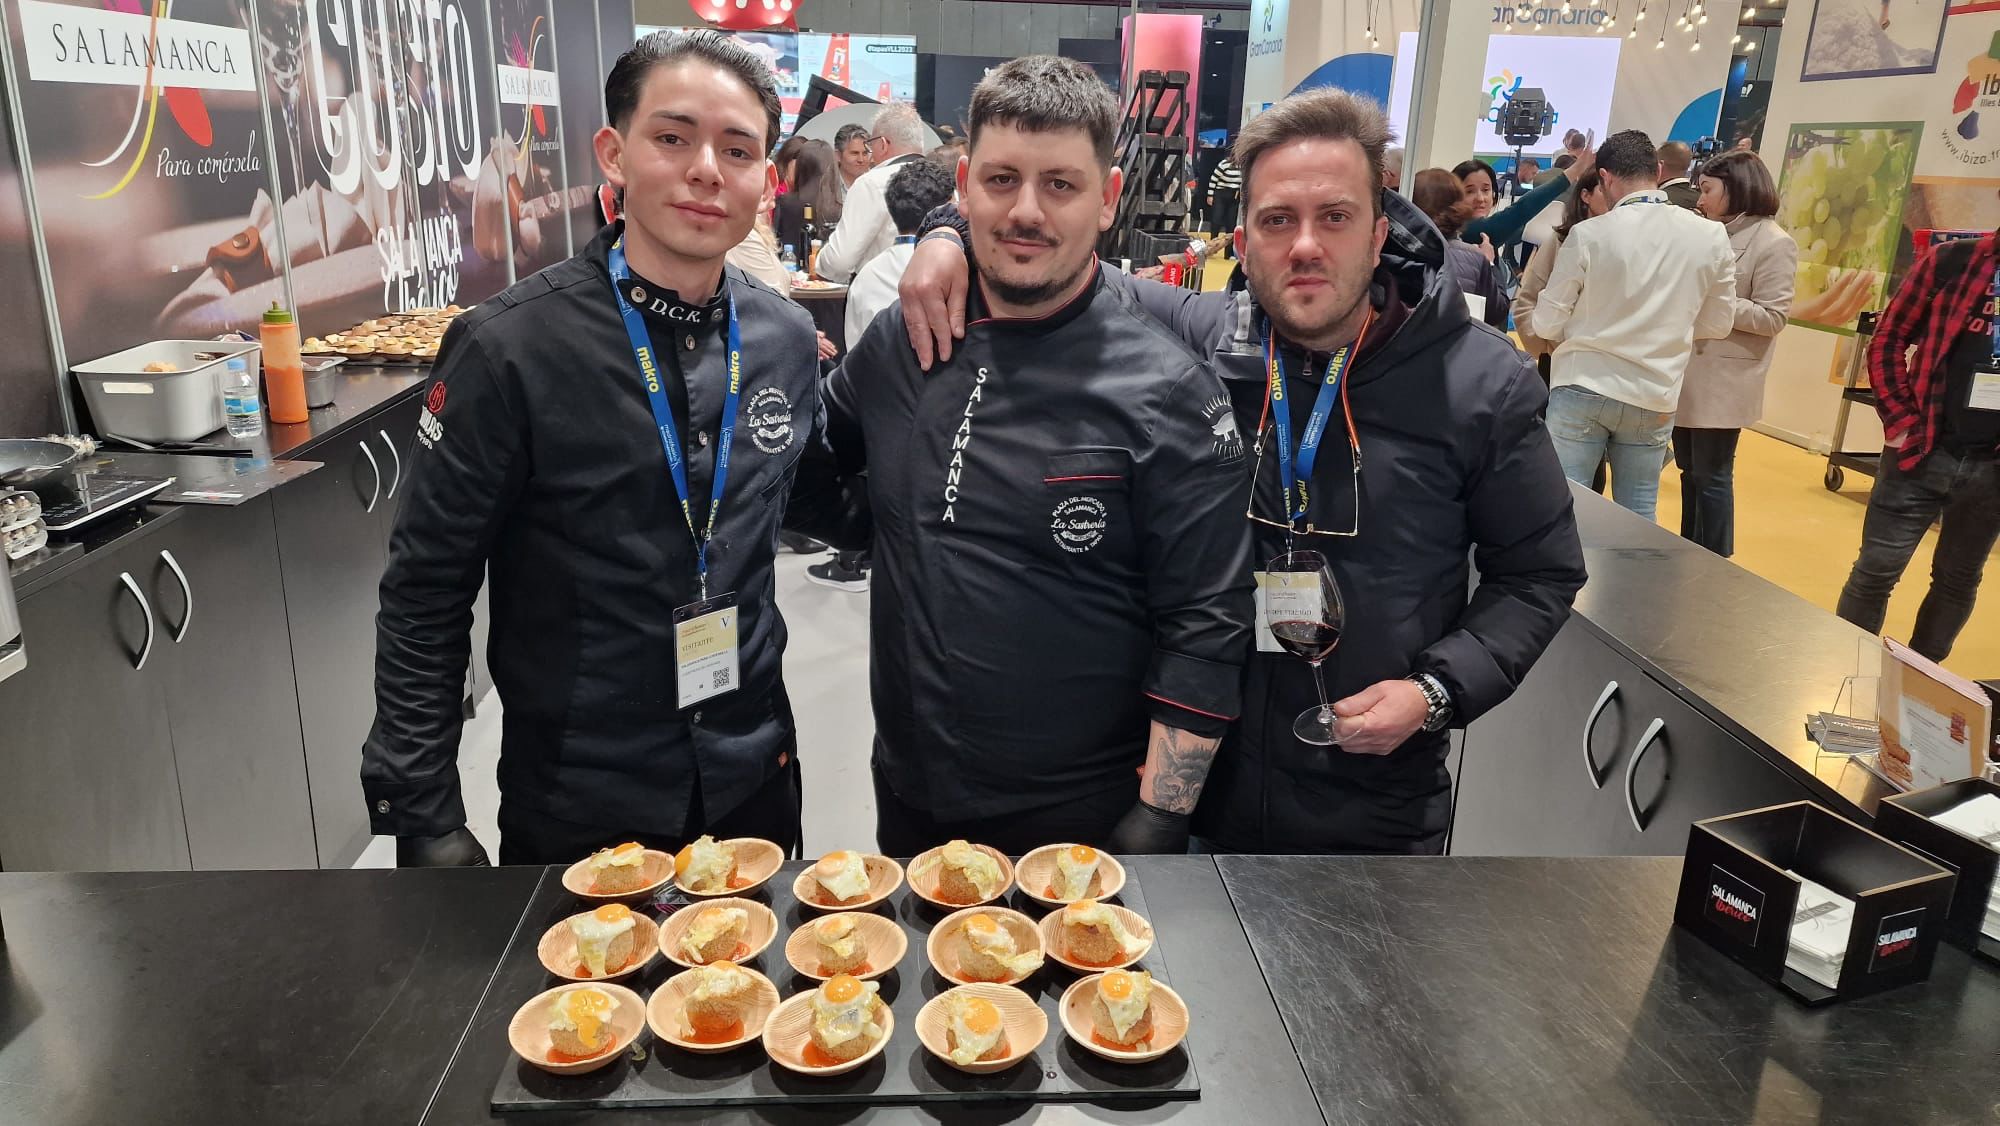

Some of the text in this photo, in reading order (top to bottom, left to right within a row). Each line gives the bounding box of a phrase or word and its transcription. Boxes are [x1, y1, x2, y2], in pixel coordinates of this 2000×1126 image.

[53, 23, 237, 74] SALAMANCA
[156, 129, 261, 184] Para comérsela
[636, 346, 660, 393] makro
[729, 350, 740, 394] makro
[1271, 360, 1283, 401] makro
[1326, 347, 1348, 385] makro
[748, 414, 761, 427] La
[942, 367, 988, 523] SALAMANCA
[1063, 505, 1098, 515] SALAMANCA
[1068, 496, 1080, 504] DEL
[1051, 518, 1067, 529] La
[721, 616, 730, 629] V
[1711, 884, 1757, 920] SALAMANCA
[1878, 926, 1917, 946] SALAMANCA
